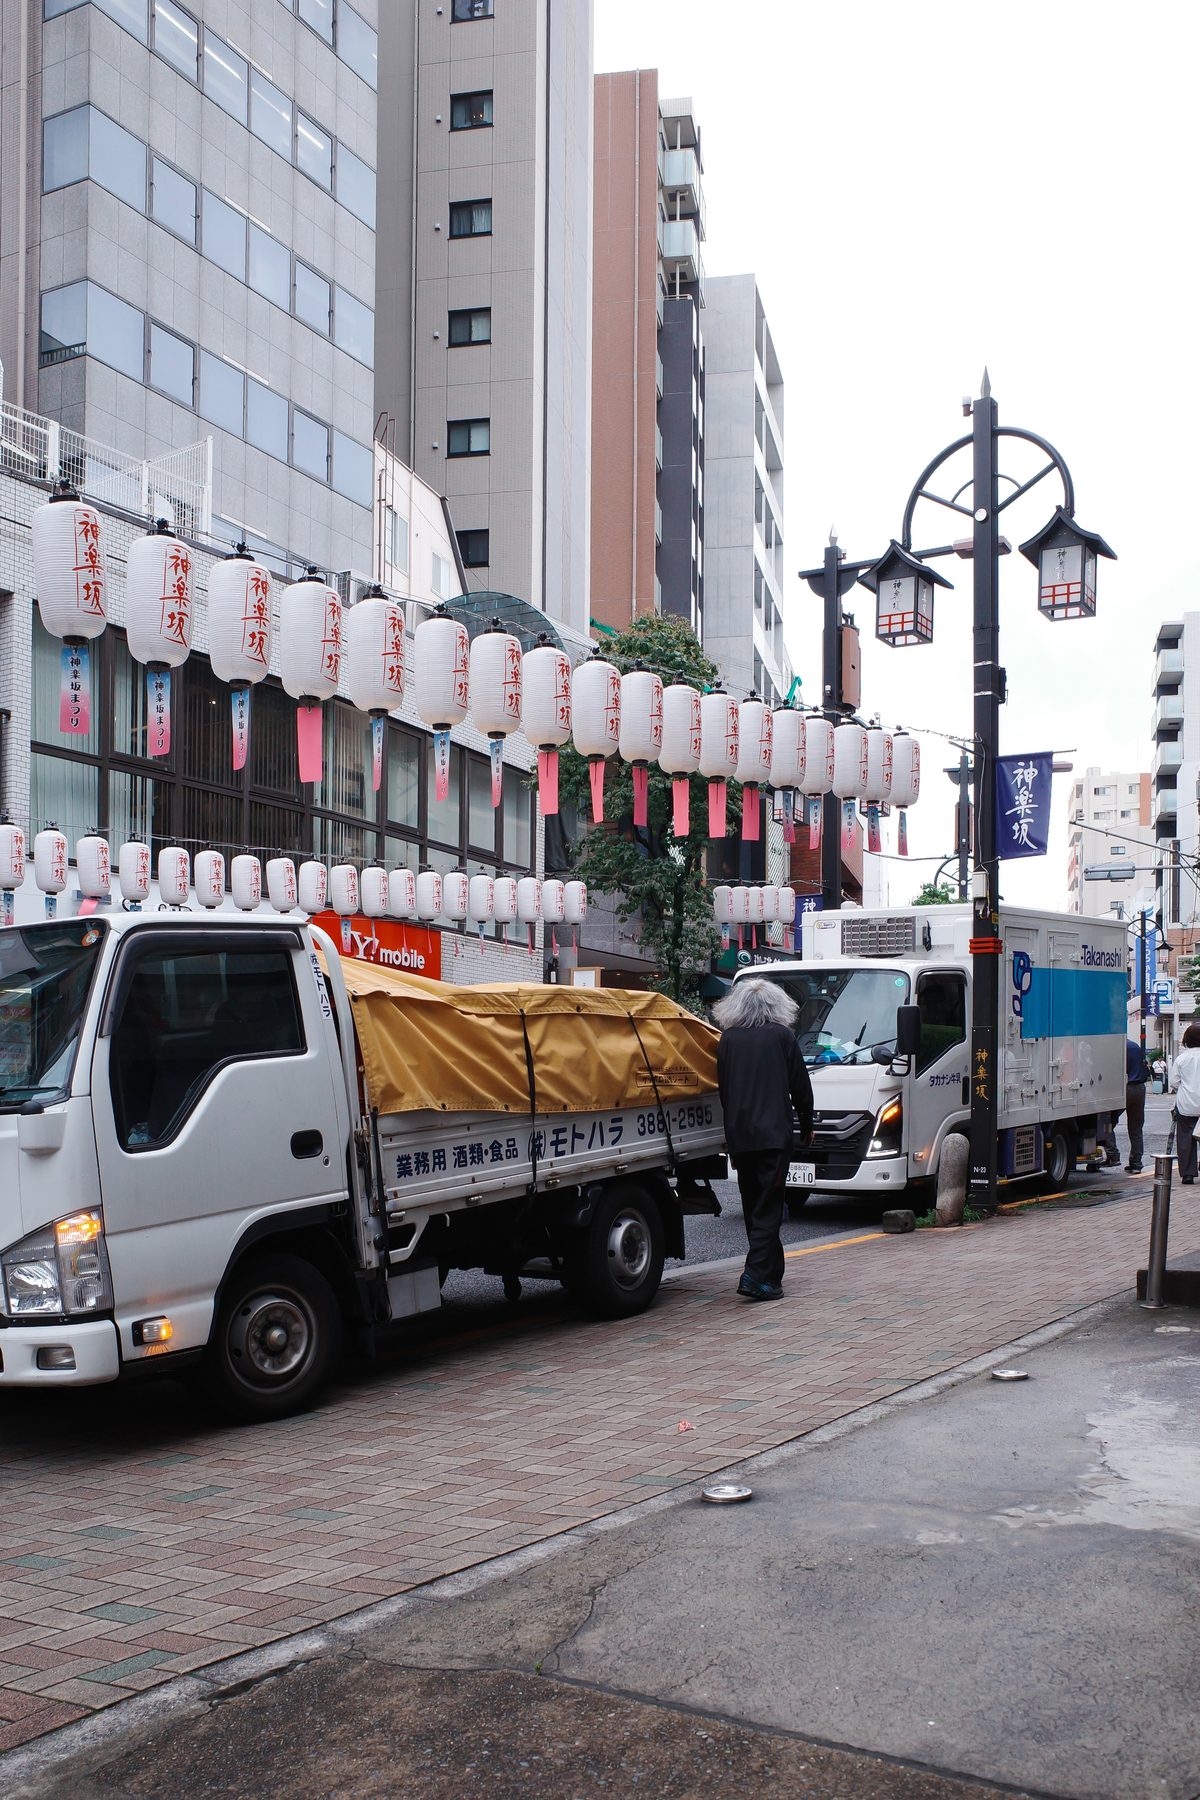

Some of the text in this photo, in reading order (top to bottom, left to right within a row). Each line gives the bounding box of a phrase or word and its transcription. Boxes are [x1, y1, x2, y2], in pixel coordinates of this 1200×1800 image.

[73, 512, 105, 614] 神楽坂
[160, 547, 192, 646] 神楽坂
[241, 571, 270, 664] 神楽坂
[321, 595, 342, 682] 神楽坂
[382, 609, 405, 693] 神楽坂
[69, 657, 81, 728] 神楽坂まつり
[452, 629, 469, 707] 神楽坂
[502, 641, 522, 720] 神楽坂
[554, 658, 571, 730] 神楽坂
[155, 681, 164, 748] 神楽坂まつり
[604, 672, 621, 739] 神楽坂
[649, 680, 663, 746] 神楽坂
[725, 701, 739, 763] 神楽坂
[759, 709, 772, 767] 神楽坂
[1005, 761, 1038, 849] 神楽坂
[10, 832, 24, 878] 神楽坂
[52, 838, 65, 883] 神楽坂
[98, 844, 110, 886] 神楽坂
[137, 850, 149, 891] 神楽坂
[176, 854, 188, 894] 神楽坂
[210, 857, 223, 897] 神楽坂
[1082, 944, 1122, 968] Takanashi
[972, 1048, 990, 1100] 神楽坂
[396, 1149, 446, 1179] 業務用
[637, 1104, 713, 1136] 3881-2595
